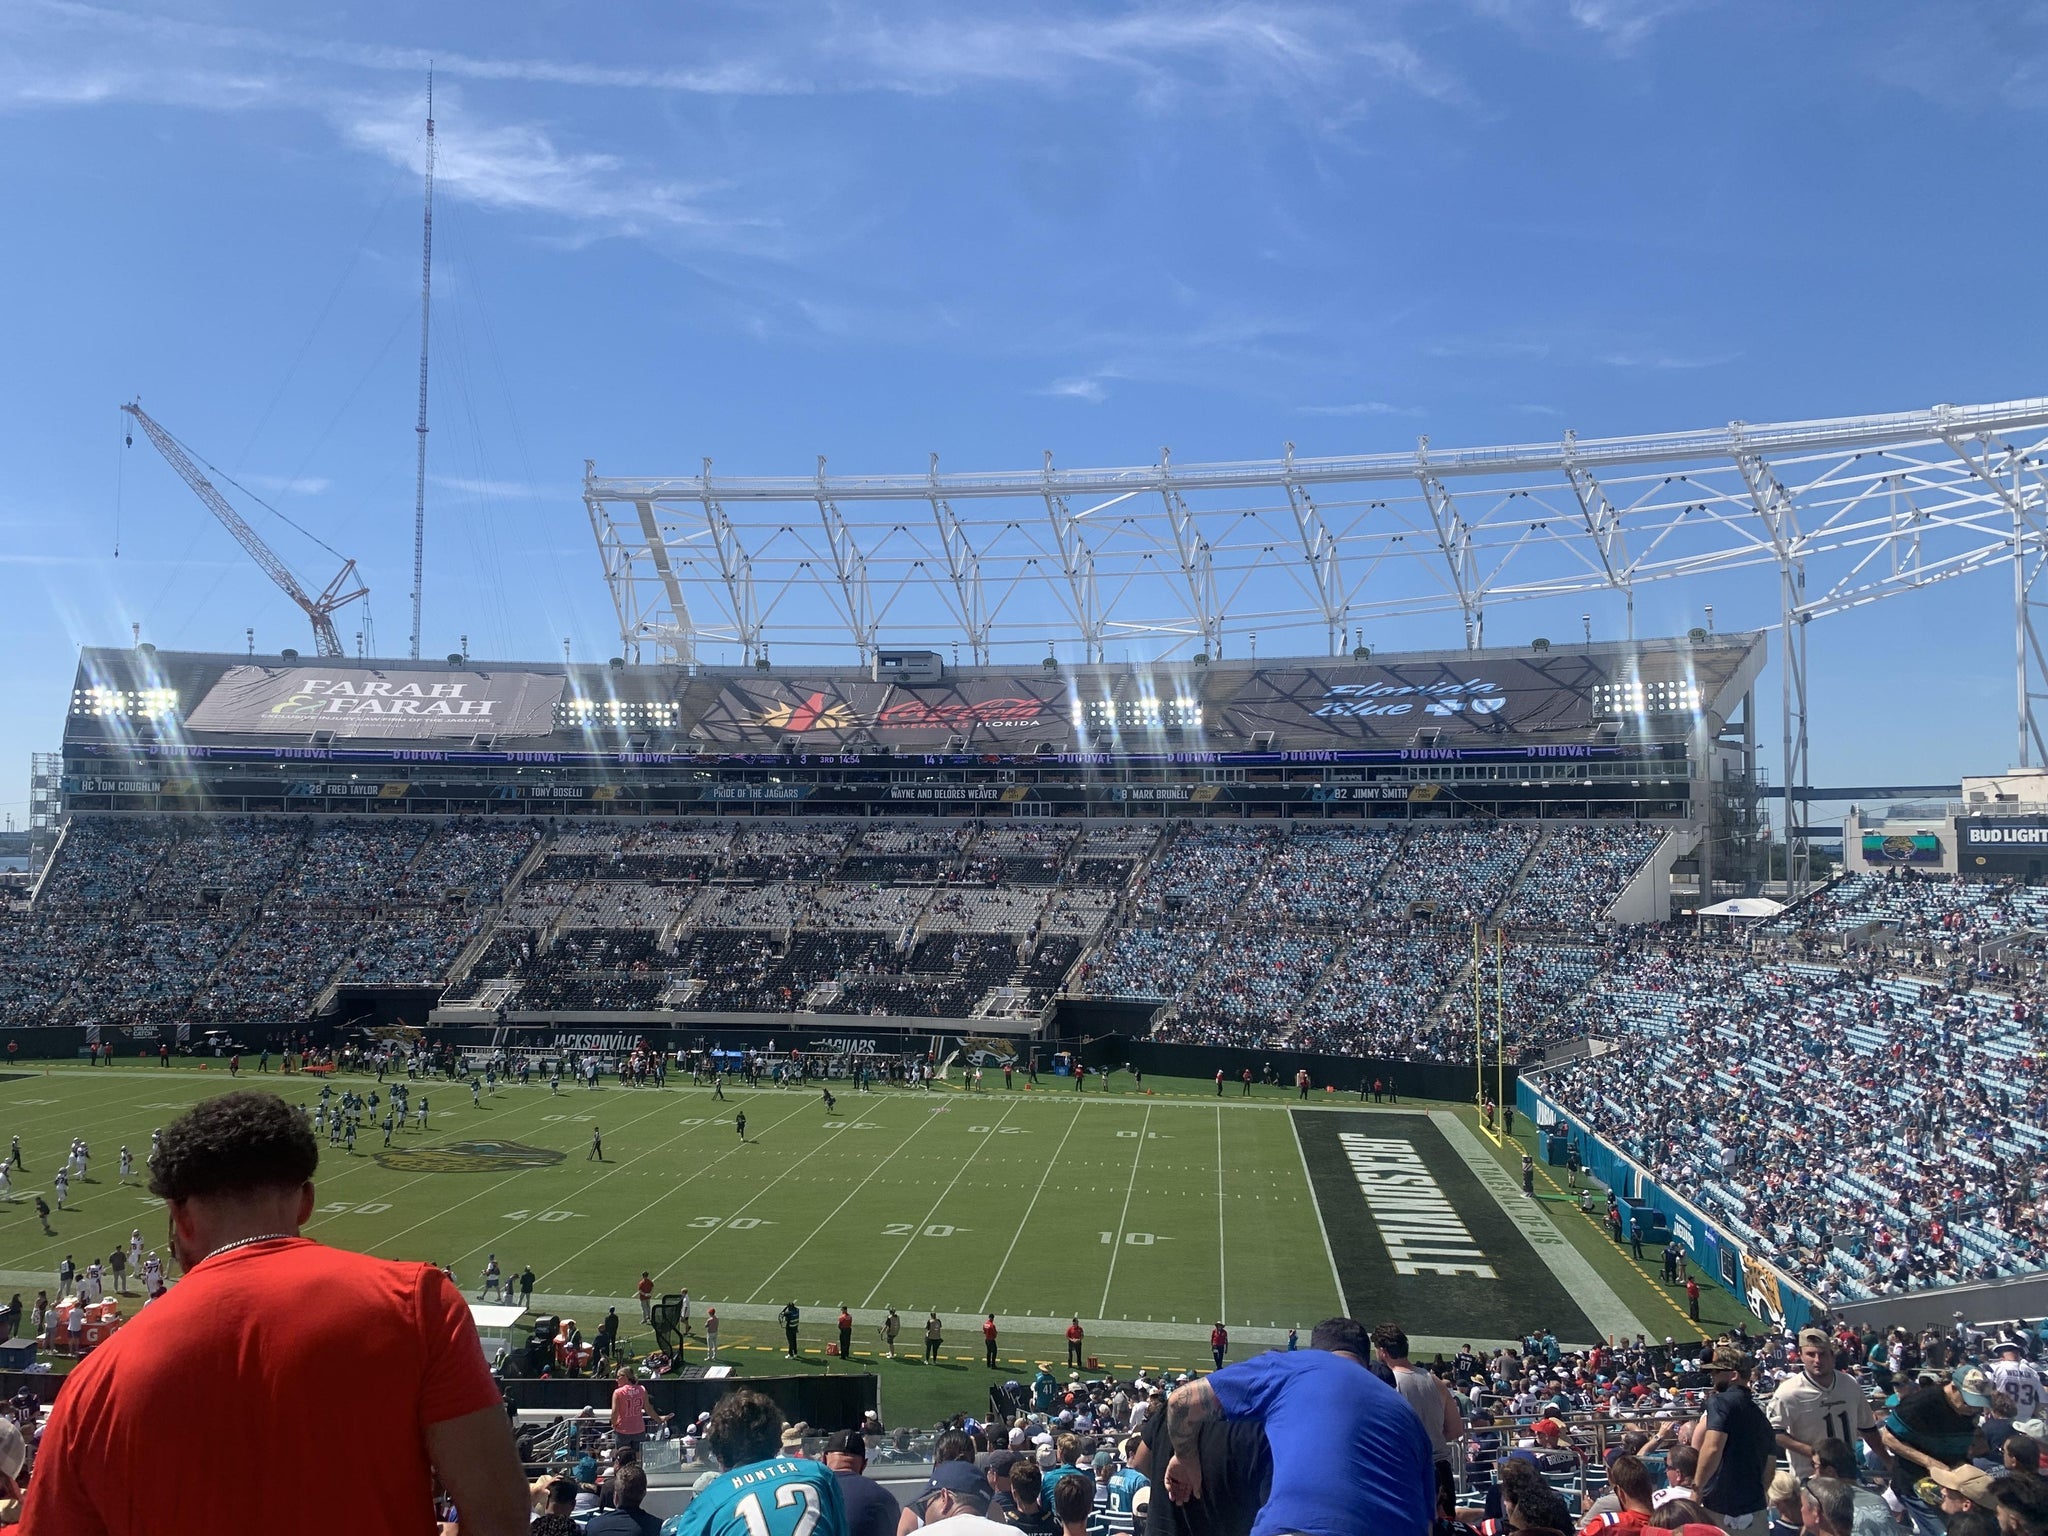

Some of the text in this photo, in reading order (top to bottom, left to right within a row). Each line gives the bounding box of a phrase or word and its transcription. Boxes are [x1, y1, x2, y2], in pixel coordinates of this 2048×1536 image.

[297, 679, 468, 698] FARAH
[1322, 678, 1503, 699] Florida
[323, 698, 498, 715] FARAH
[1308, 700, 1414, 717] Blue
[882, 720, 1040, 729] BEVERAGES FLORIDA
[800, 755, 807, 764] 3
[839, 755, 860, 764] 14:54
[924, 755, 935, 764] 14
[82, 781, 94, 791] HC
[97, 781, 115, 791] TOM
[118, 781, 161, 792] COUGHLIN
[309, 785, 322, 794] 28
[327, 785, 347, 795] FRED
[350, 785, 378, 795] TAYLOR
[531, 788, 551, 797] TONY
[553, 788, 583, 797] BOSELLI
[713, 788, 798, 798] PRIDE OF THE JAGUARS
[890, 789, 915, 799] WAYNE
[917, 789, 933, 799] AND
[934, 789, 965, 799] DELORES
[968, 789, 998, 799] WEAVER
[1121, 790, 1127, 799] 8
[1132, 790, 1153, 799] MARK
[1156, 790, 1189, 799] BRUNELL
[1334, 788, 1408, 799] 82 JIMMY SMITH
[1970, 828, 2048, 843] BUD LIGHT
[551, 1034, 643, 1050] JACKSONVILLE
[967, 1125, 1022, 1134] 20
[1116, 1130, 1156, 1139] 10
[1475, 1167, 1518, 1192] TAKES
[318, 1202, 394, 1215] 50
[1336, 1132, 1500, 1280] JACKSONVILLE
[502, 1209, 574, 1223] 40
[1514, 1215, 1548, 1227] OF
[686, 1216, 761, 1230] 30
[880, 1223, 956, 1237] 20
[1098, 1231, 1155, 1246] 10
[1528, 1231, 1564, 1245] US
[147, 1265, 159, 1273] 77
[86, 1328, 98, 1342] G
[1460, 1360, 1471, 1372] 87
[1042, 1384, 1053, 1395] 41
[625, 1397, 644, 1418] 12
[1822, 1411, 1852, 1447] 11
[731, 1462, 798, 1489] HUNTER
[734, 1481, 822, 1536] 12
